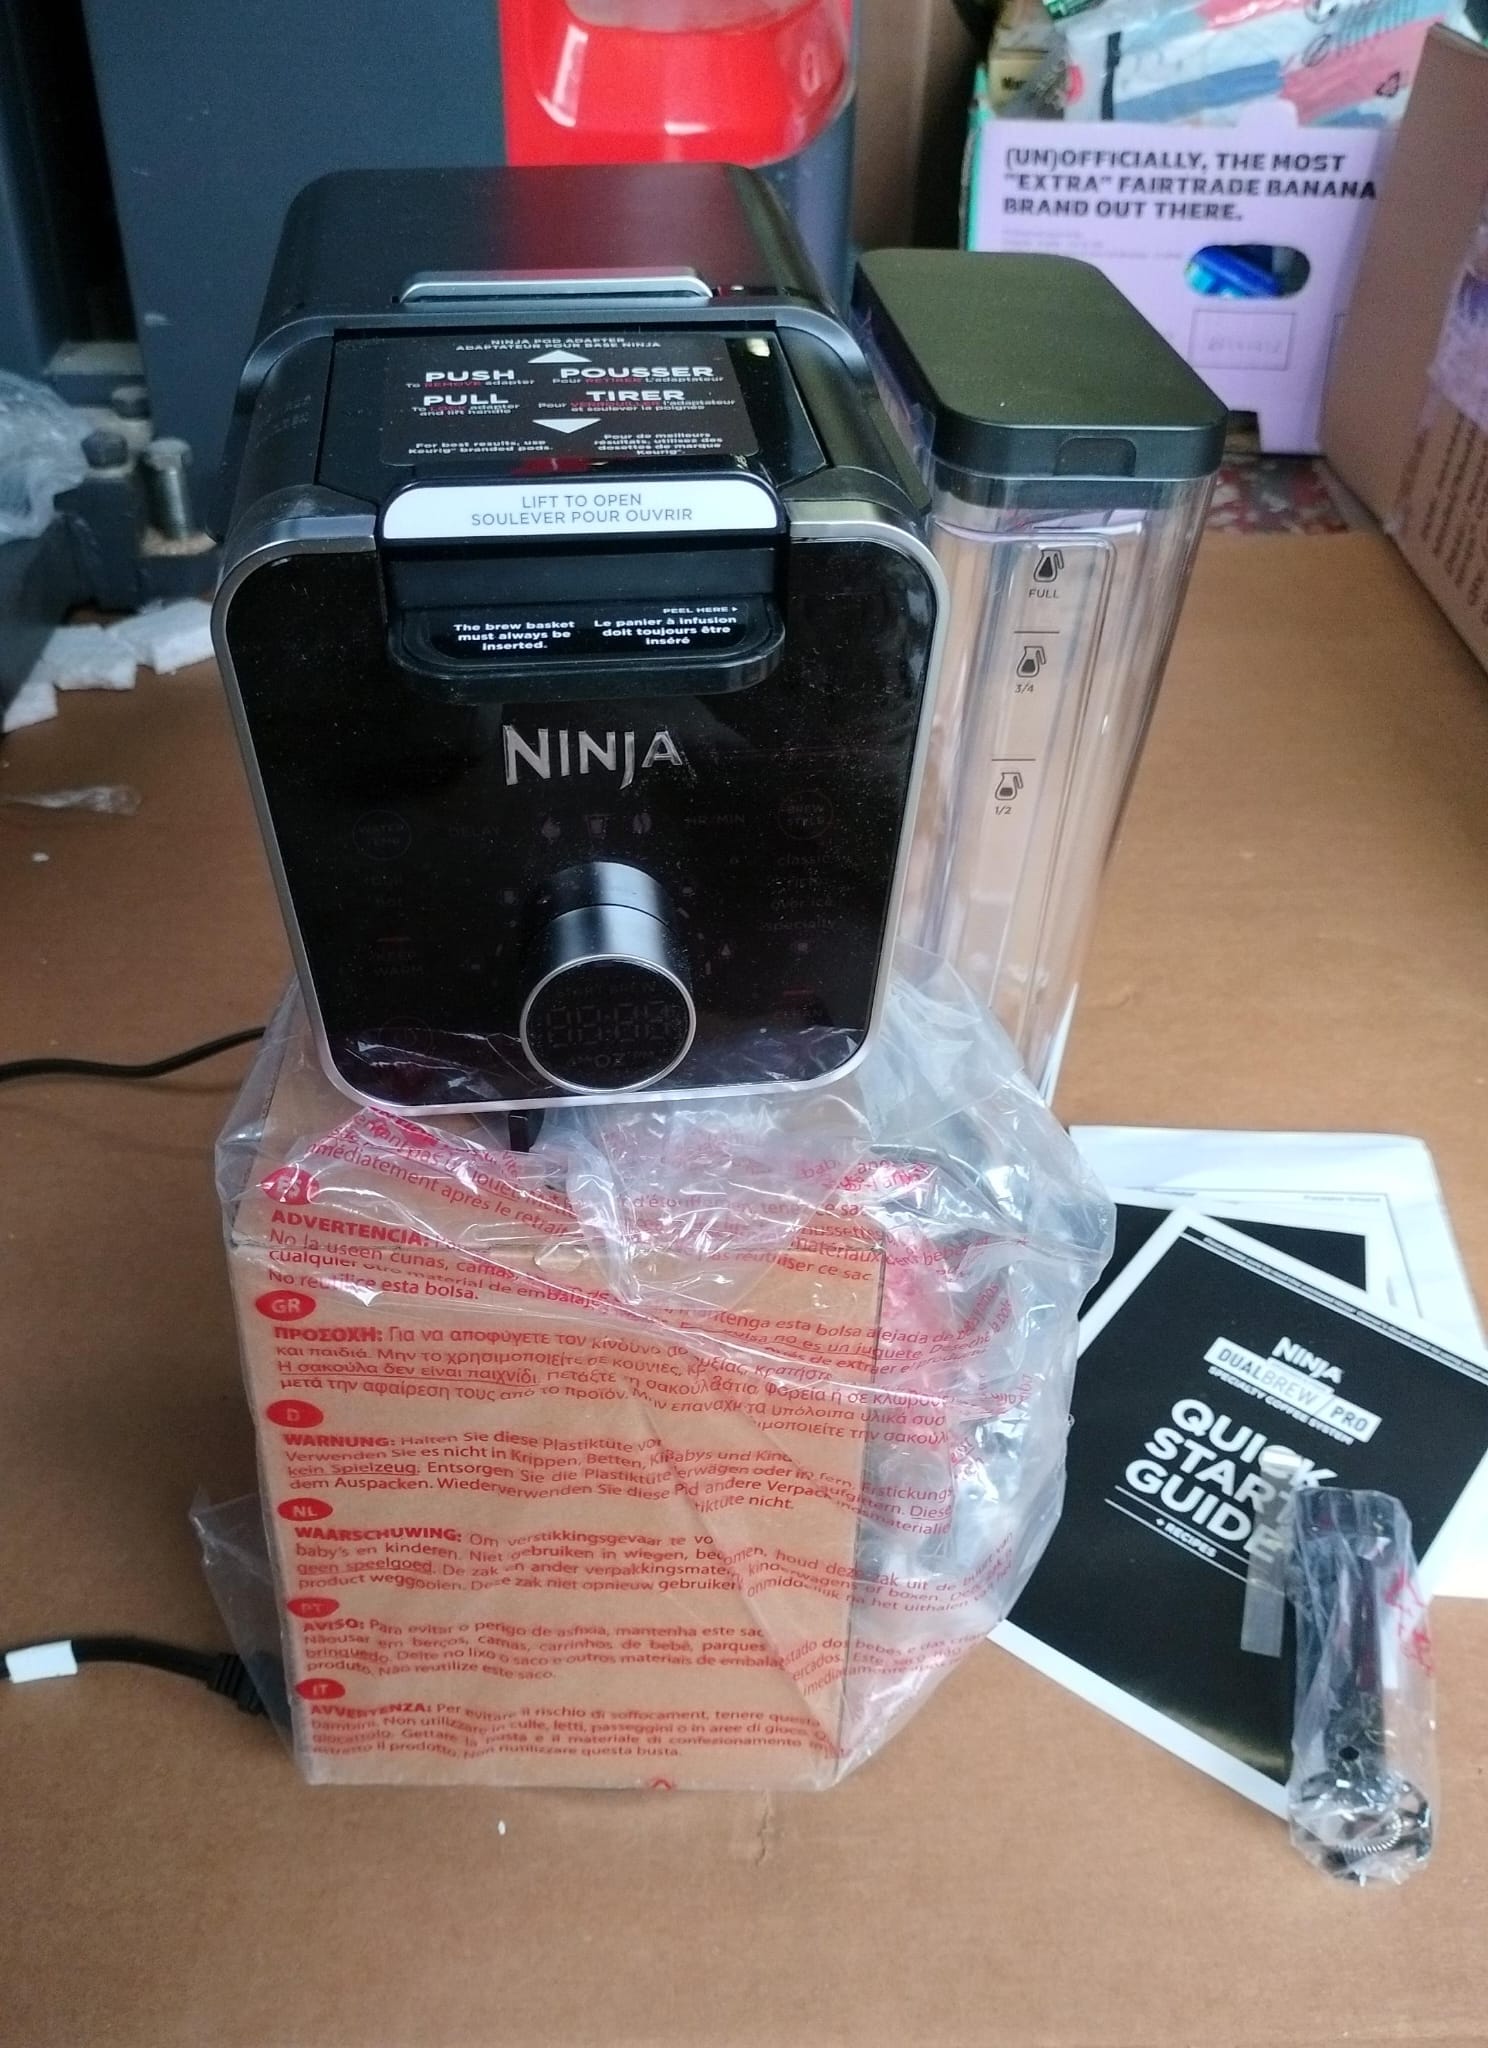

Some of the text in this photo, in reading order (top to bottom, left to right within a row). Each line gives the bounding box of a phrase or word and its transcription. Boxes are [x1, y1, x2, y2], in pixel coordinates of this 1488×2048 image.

[1006, 147, 1346, 173] (UN)OFFICIALLY, THE MOST
[1005, 173, 1377, 199] "EXTRA" FAIRTRADE BANANA
[1003, 197, 1243, 220] BRAND OUT THERE.
[456, 343, 541, 351] ADAPTATEUR
[425, 369, 515, 383] PUSH
[560, 366, 715, 378] POUSSER
[484, 378, 535, 387] adapter
[423, 394, 509, 406] PULL
[586, 390, 686, 402] TIRER
[522, 493, 642, 508] LIFT TO OPEN
[471, 508, 693, 526] SOULEVER POUR OUVRIR
[1028, 588, 1060, 599] FULL
[453, 620, 576, 632] The brew basket
[594, 615, 737, 629] Le panier à infusion
[458, 629, 571, 642] must always be
[602, 624, 731, 638] doit toujours être
[482, 640, 548, 651] inserted.
[646, 635, 691, 646] inséré
[1014, 683, 1034, 693] 3/4
[502, 724, 684, 790] NINJA
[994, 806, 1012, 815] 1/2
[441, 1183, 569, 1238] après le retrait
[271, 1209, 429, 1247] ADVERTENCIA:
[269, 1228, 296, 1245] No
[390, 1252, 448, 1271] cunas,
[269, 1250, 358, 1268] cualquier
[381, 1280, 479, 1300] esta bolsa.
[271, 1298, 301, 1313] GR
[274, 1325, 550, 1346] ΠΡΟΣΟΧΗ: Για να αποφύγετε
[776, 1320, 862, 1338] esta bolsa
[377, 1349, 417, 1362] Μην
[1271, 1336, 1344, 1384] NINJA
[278, 1361, 462, 1378] Η σακούλα δεν είναι
[280, 1377, 496, 1402] μετά αφαίρεση τους
[1207, 1365, 1268, 1400] SPECIALTY
[1217, 1348, 1369, 1433] DUALBREW PRO
[282, 1430, 633, 1453] WARNUNG: Sie diese Plastiktüte
[420, 1446, 647, 1470] es nicht in Krippen, Betten,
[331, 1461, 577, 1482] Spielzeug. Entsorgen die
[289, 1477, 593, 1500] dem Auspacken. Wiederverwenden
[292, 1505, 318, 1517] NL
[748, 1496, 794, 1510] nicht.
[294, 1527, 499, 1548] WAARSCHUWING: Om
[385, 1542, 463, 1561] kinderen.
[469, 1550, 504, 1562] Niet
[623, 1549, 688, 1562] wiegen,
[346, 1557, 578, 1575] speelgoed. ander
[300, 1572, 467, 1591] product weggooien.
[303, 1618, 365, 1633] AVISO:
[702, 1640, 766, 1654] parques
[312, 1684, 328, 1696] IT
[715, 1709, 765, 1721] tenere
